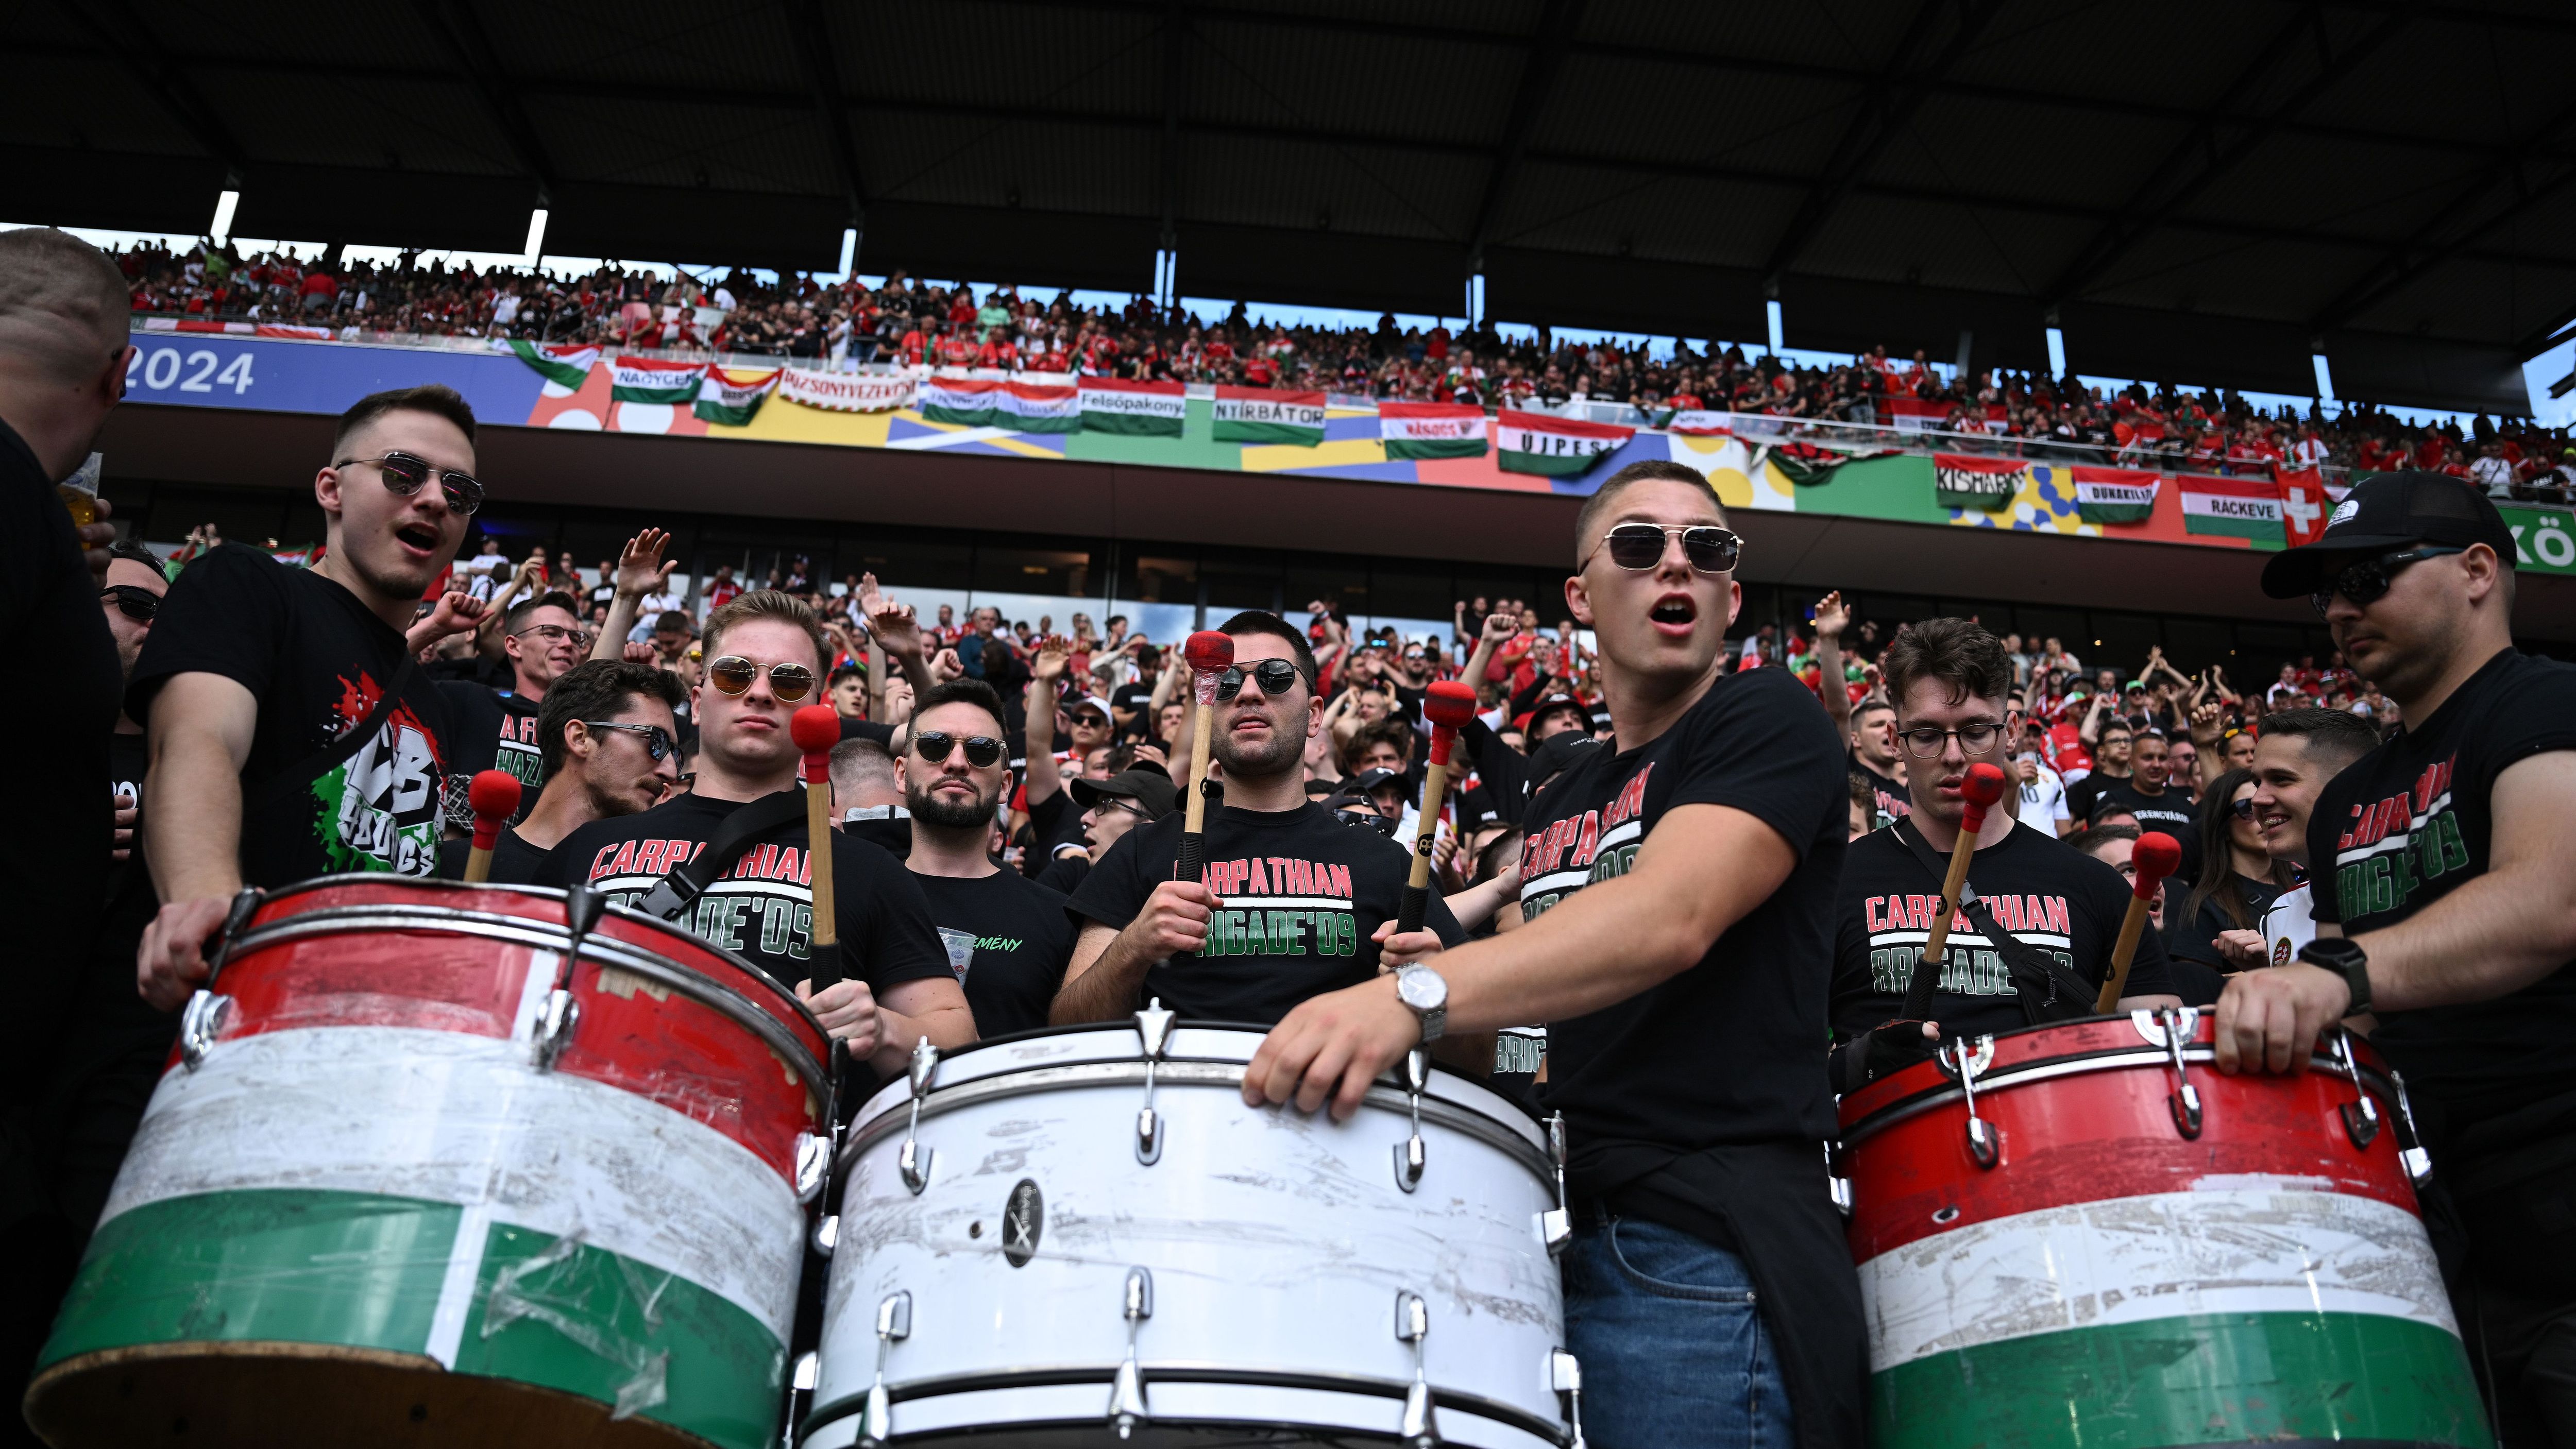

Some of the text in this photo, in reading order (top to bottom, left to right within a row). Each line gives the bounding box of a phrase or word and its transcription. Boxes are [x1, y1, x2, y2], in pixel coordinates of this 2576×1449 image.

[125, 344, 254, 395] 2024
[1216, 401, 1325, 425] NYÍRBÁTOR
[1521, 429, 1613, 455] ÚJPES
[2211, 498, 2275, 519] RÁCKEVE
[495, 748, 544, 788] HAZ
[2021, 786, 2040, 804] 10
[1174, 857, 1353, 898] ARPATHIAN
[1194, 911, 1357, 958] RIGADE'09
